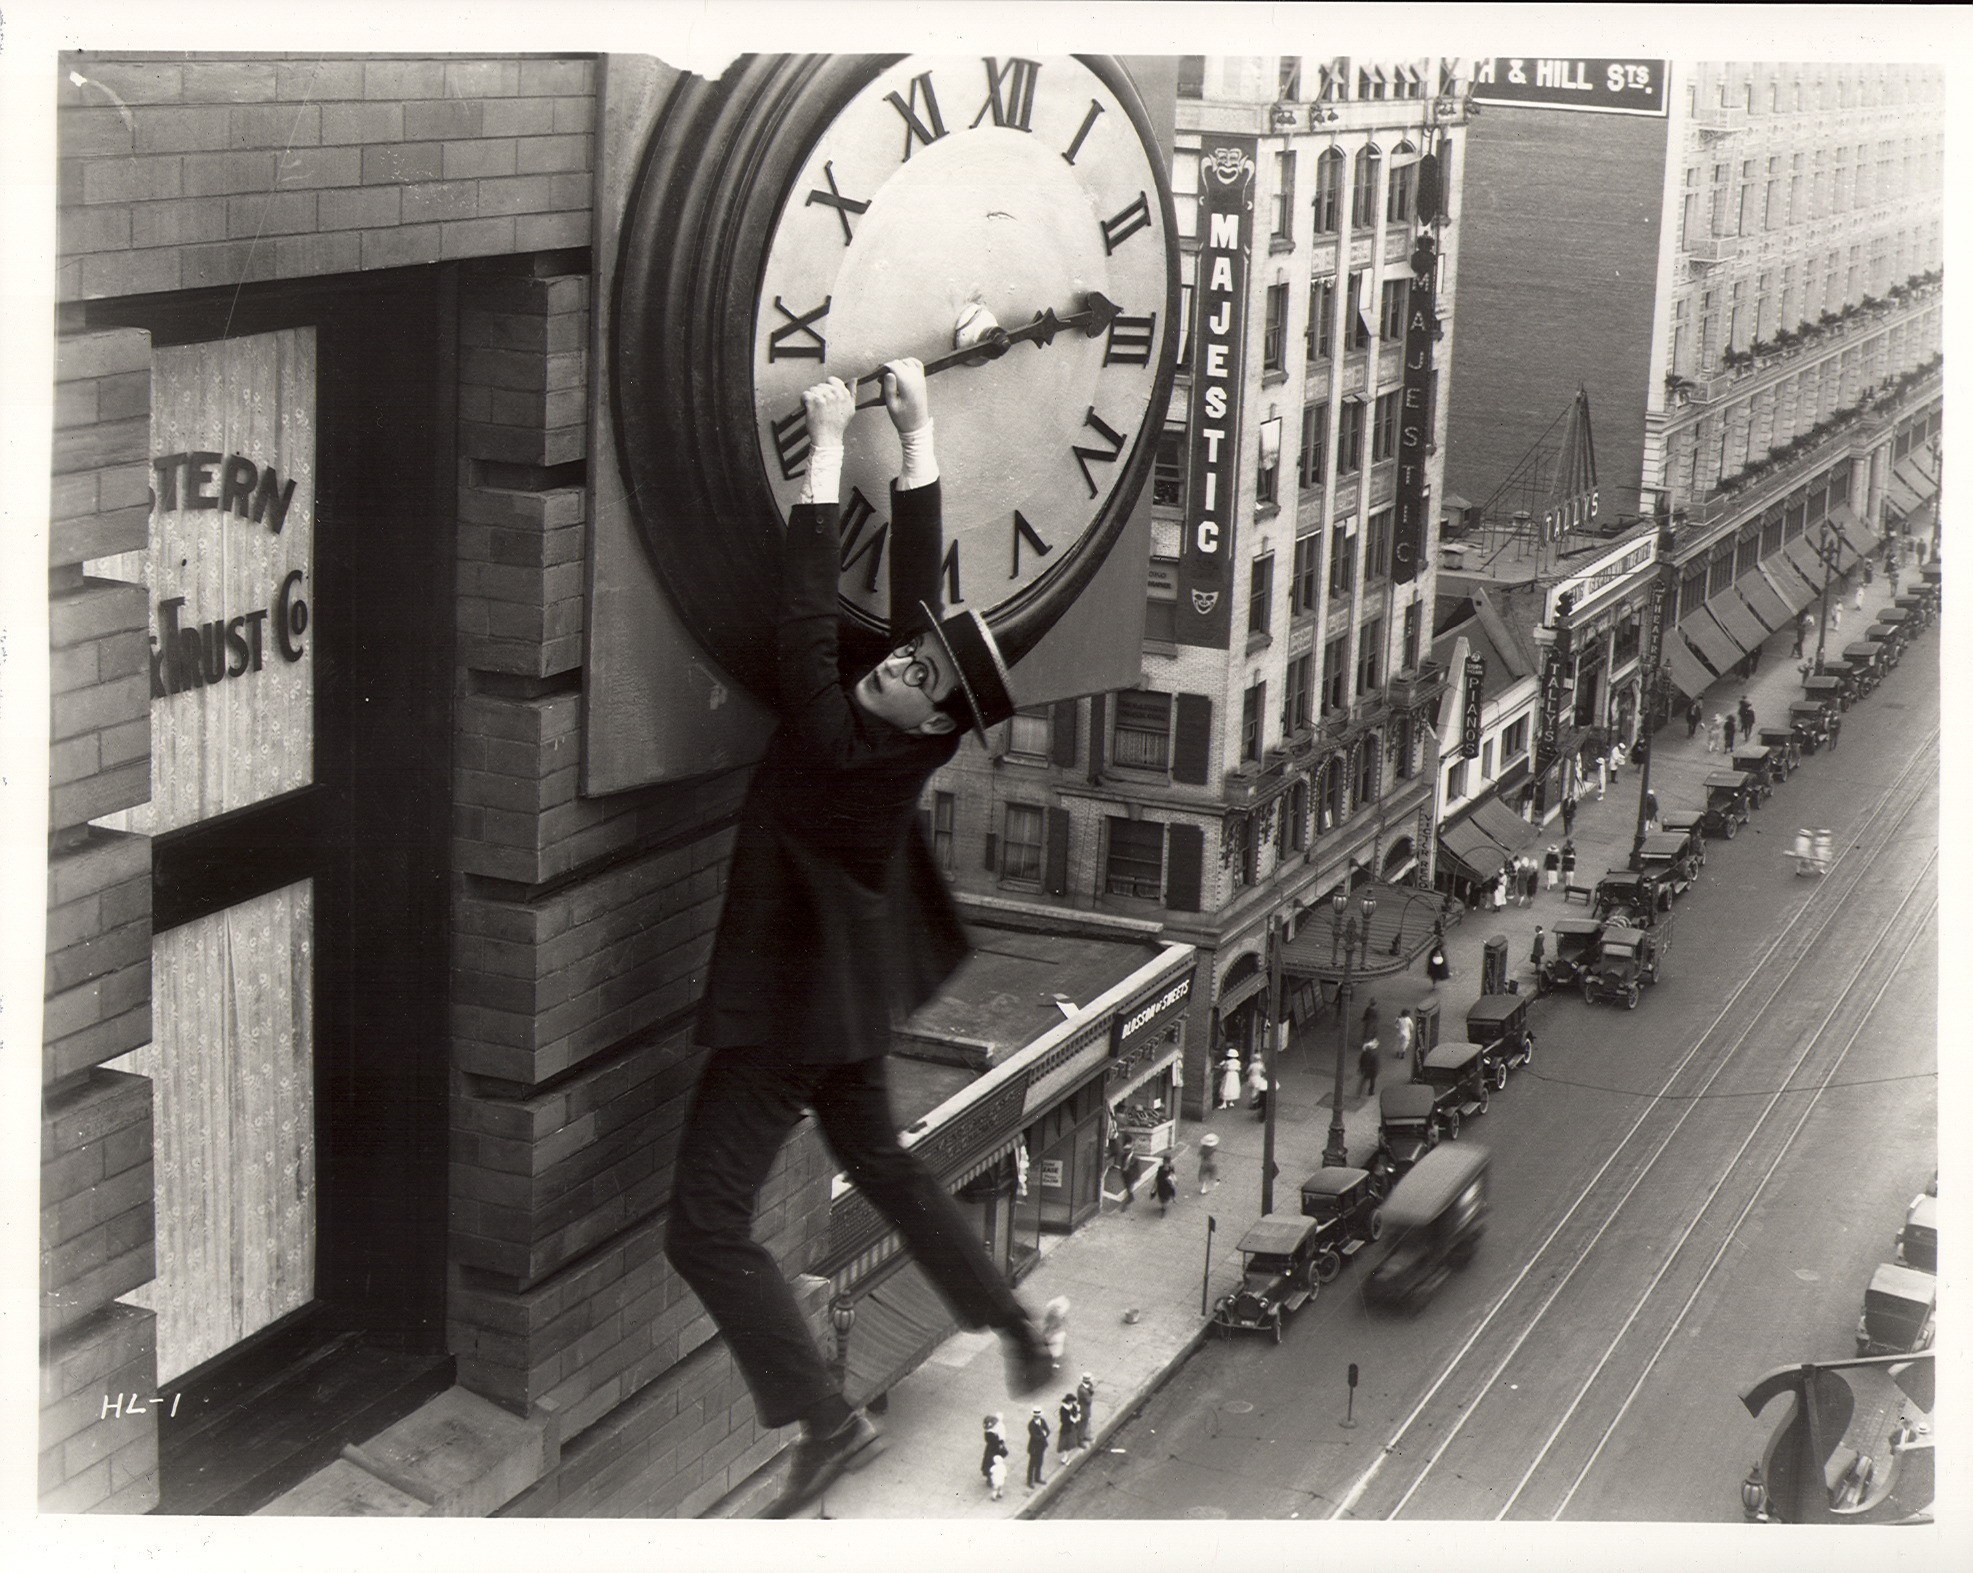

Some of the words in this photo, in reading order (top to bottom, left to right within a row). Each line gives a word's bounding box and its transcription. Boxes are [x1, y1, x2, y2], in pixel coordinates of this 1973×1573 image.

[969, 56, 1043, 133] XII
[1508, 60, 1527, 84] &
[1536, 60, 1593, 90] HILL
[882, 69, 950, 162] XI
[1061, 98, 1105, 165] I
[806, 160, 872, 246] X
[1101, 190, 1152, 256] II
[769, 295, 832, 364] IX
[1103, 312, 1156, 369] III
[1197, 213, 1239, 553] MAJESTIC
[1397, 272, 1430, 562] MAJESTIC
[149, 451, 297, 535] TERN
[1010, 509, 1053, 580] V
[160, 597, 268, 696] TRUST
[1464, 677, 1480, 754] PIANOS
